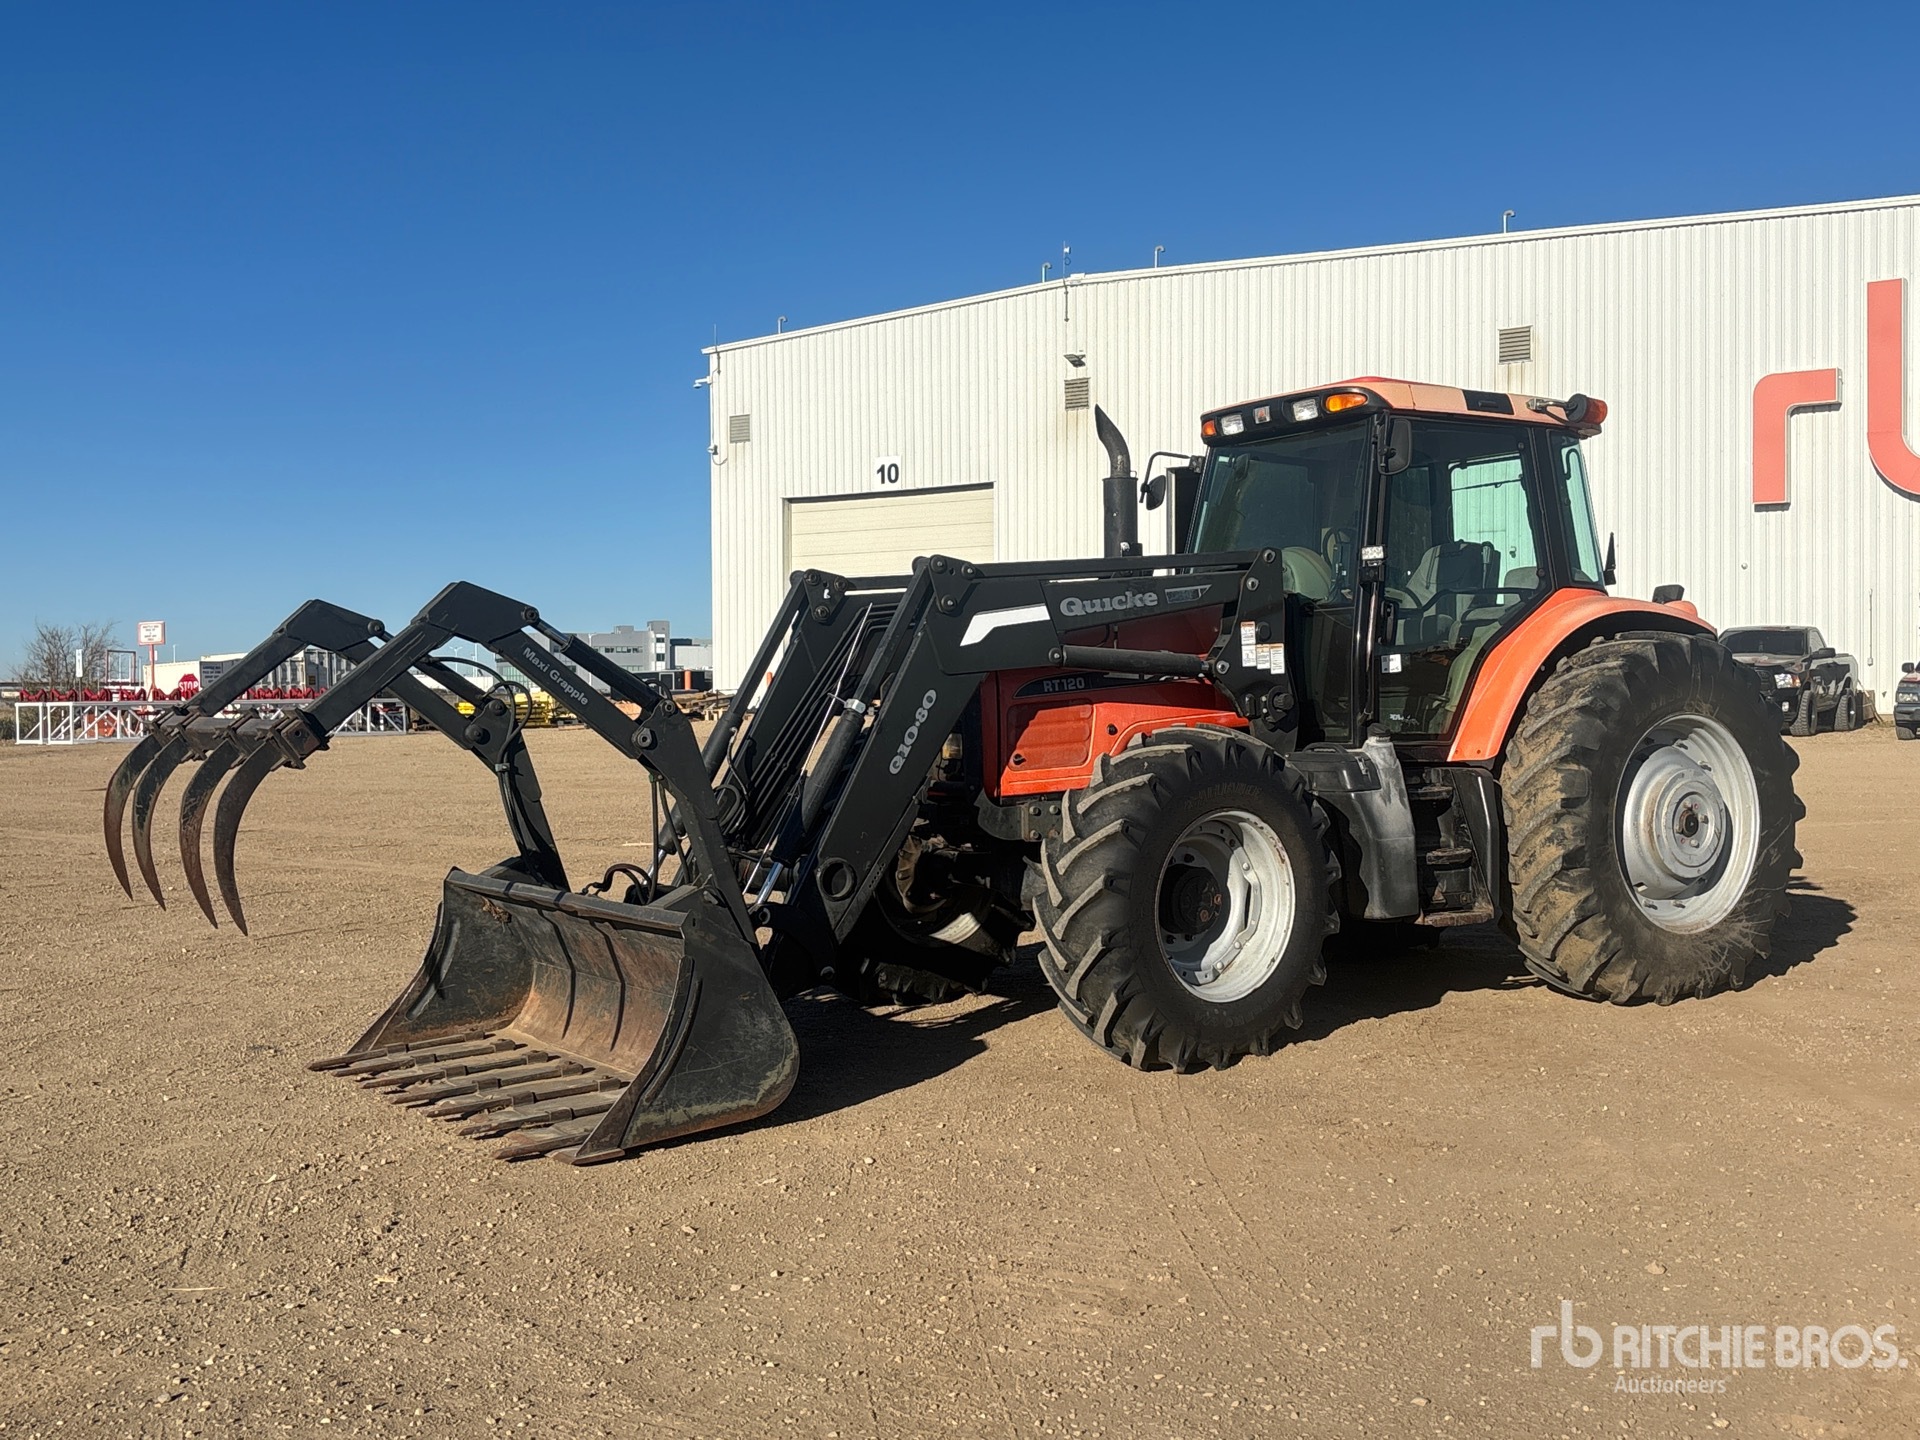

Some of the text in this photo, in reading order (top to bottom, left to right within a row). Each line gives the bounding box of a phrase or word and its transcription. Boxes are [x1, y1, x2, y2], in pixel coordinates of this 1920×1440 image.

[876, 462, 900, 485] 10
[1059, 590, 1158, 617] Quicke
[178, 680, 200, 693] STOP
[523, 647, 589, 705] Maxi Grapple
[1043, 677, 1086, 693] RT120
